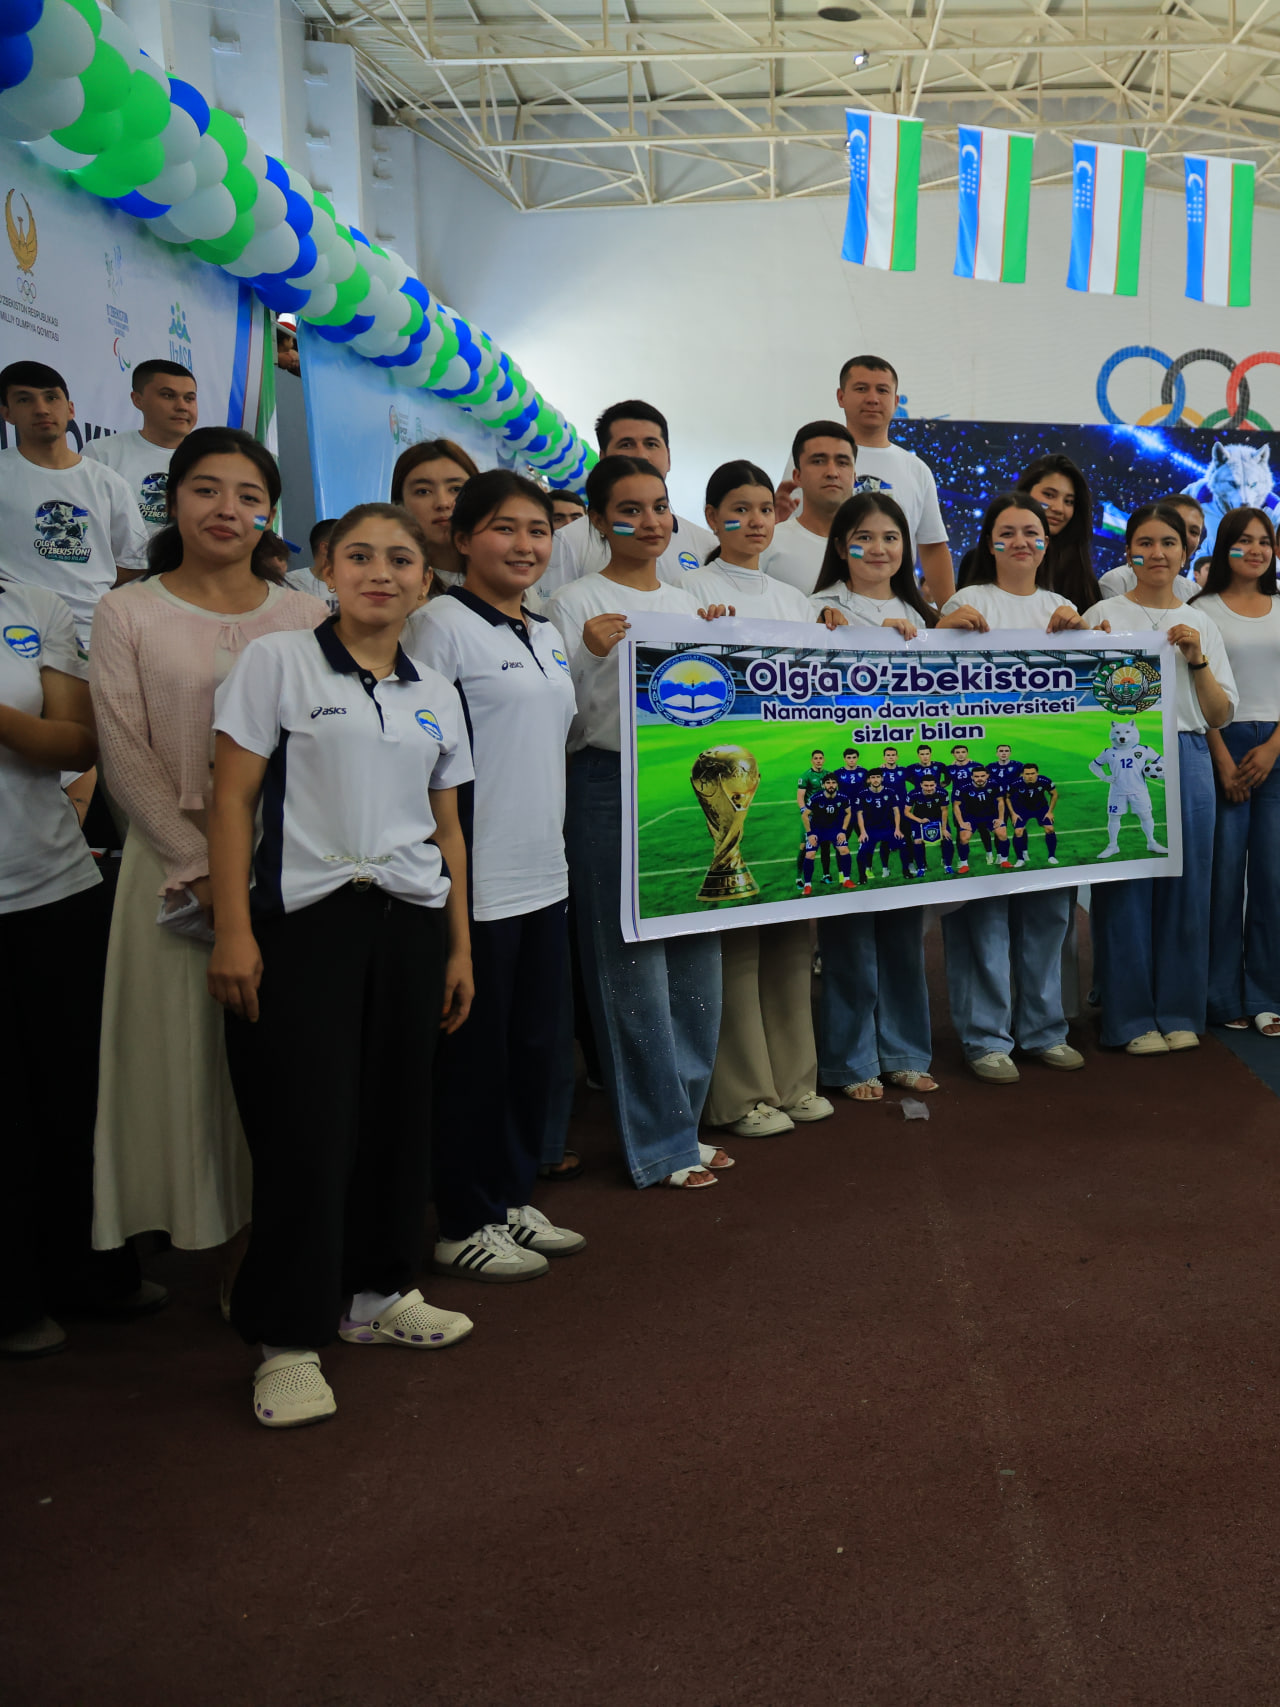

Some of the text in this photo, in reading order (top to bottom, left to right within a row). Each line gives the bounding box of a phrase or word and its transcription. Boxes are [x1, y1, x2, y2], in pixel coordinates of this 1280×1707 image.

[763, 698, 1075, 723] Namangan davlat universiteti
[853, 722, 984, 742] sizlar bilan
[1120, 758, 1134, 769] 12
[850, 775, 856, 784] 2
[957, 771, 968, 780] 23
